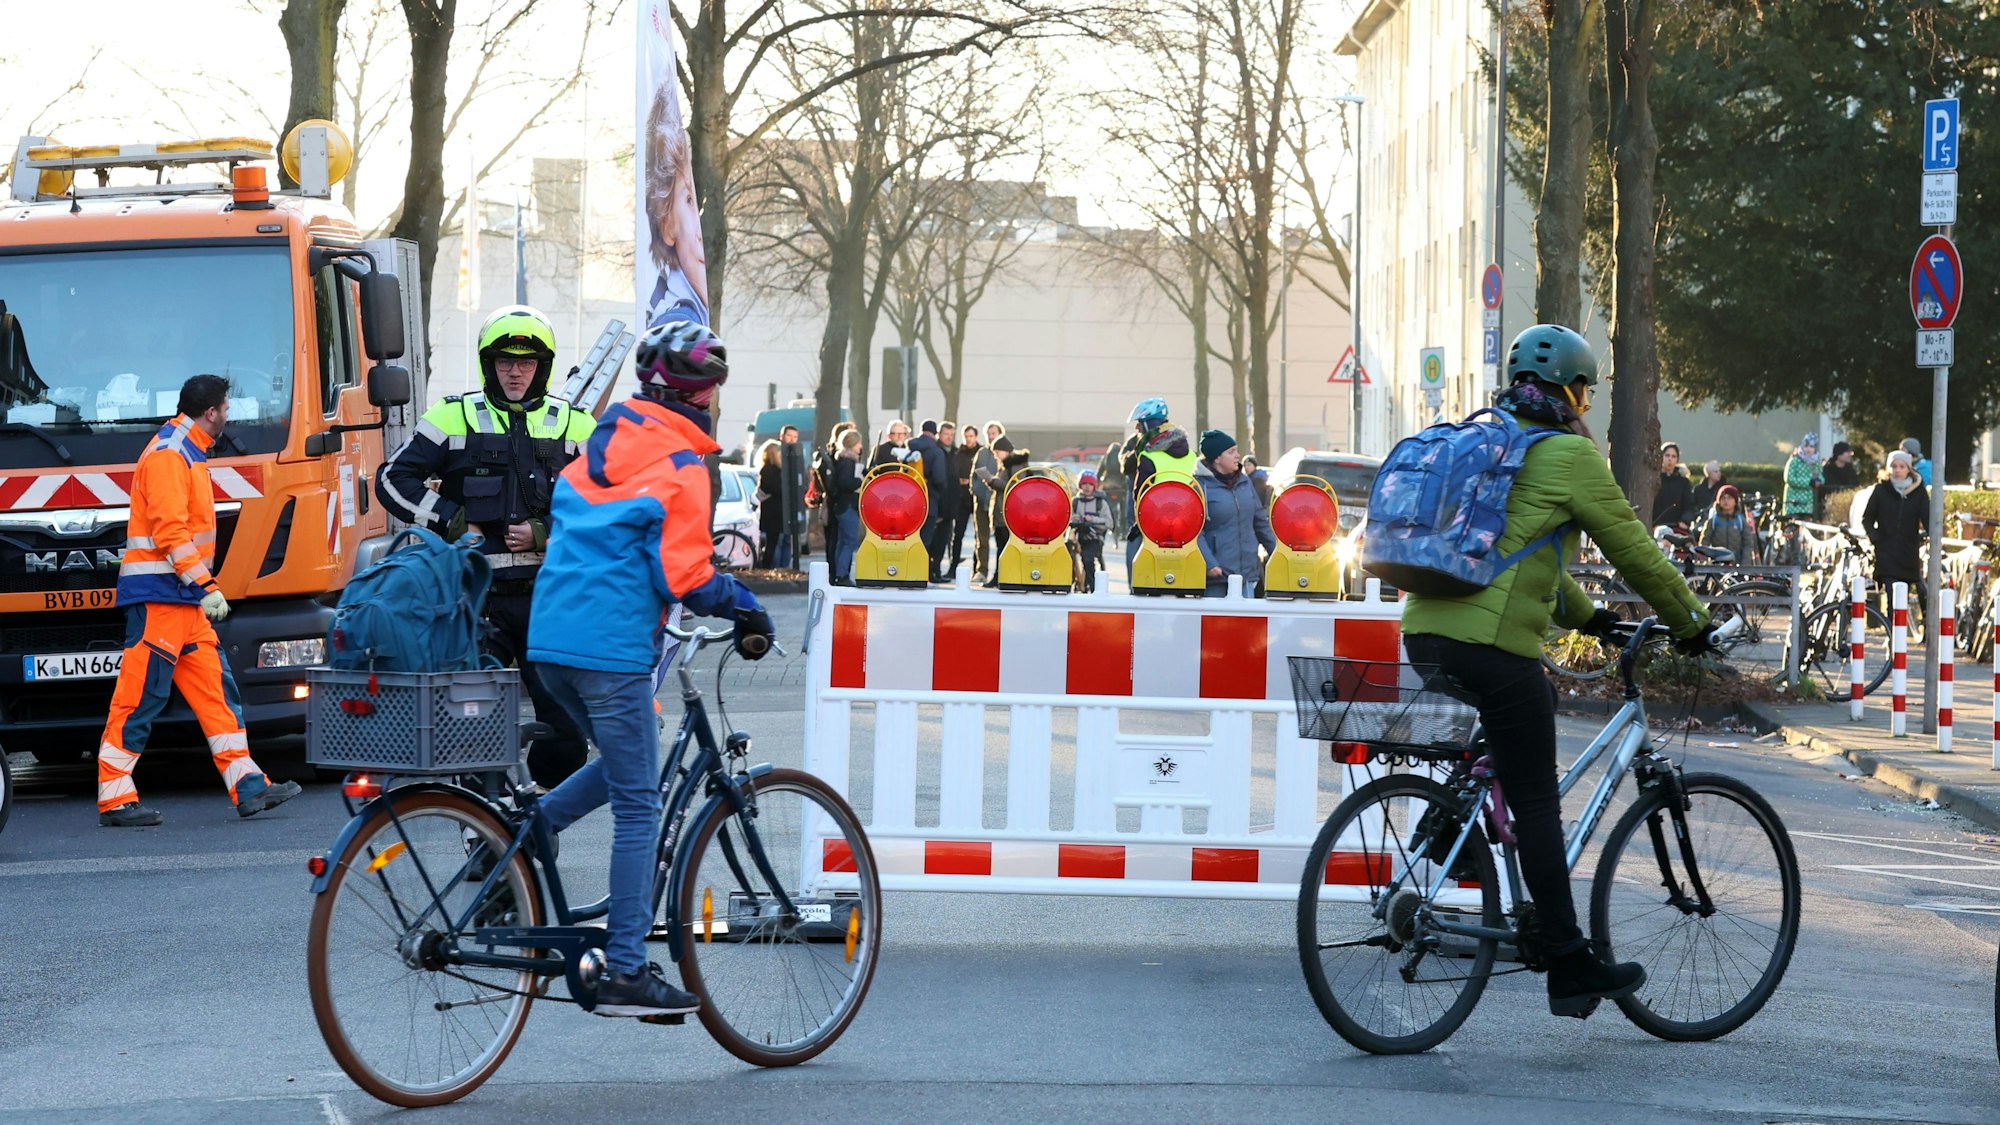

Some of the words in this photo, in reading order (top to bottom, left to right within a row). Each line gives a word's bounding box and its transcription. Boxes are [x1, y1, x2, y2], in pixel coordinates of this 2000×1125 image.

[1931, 109, 1950, 161] P
[25, 549, 126, 573] MAN
[44, 591, 85, 609] BVB
[90, 590, 113, 607] 09
[37, 659, 48, 677] K
